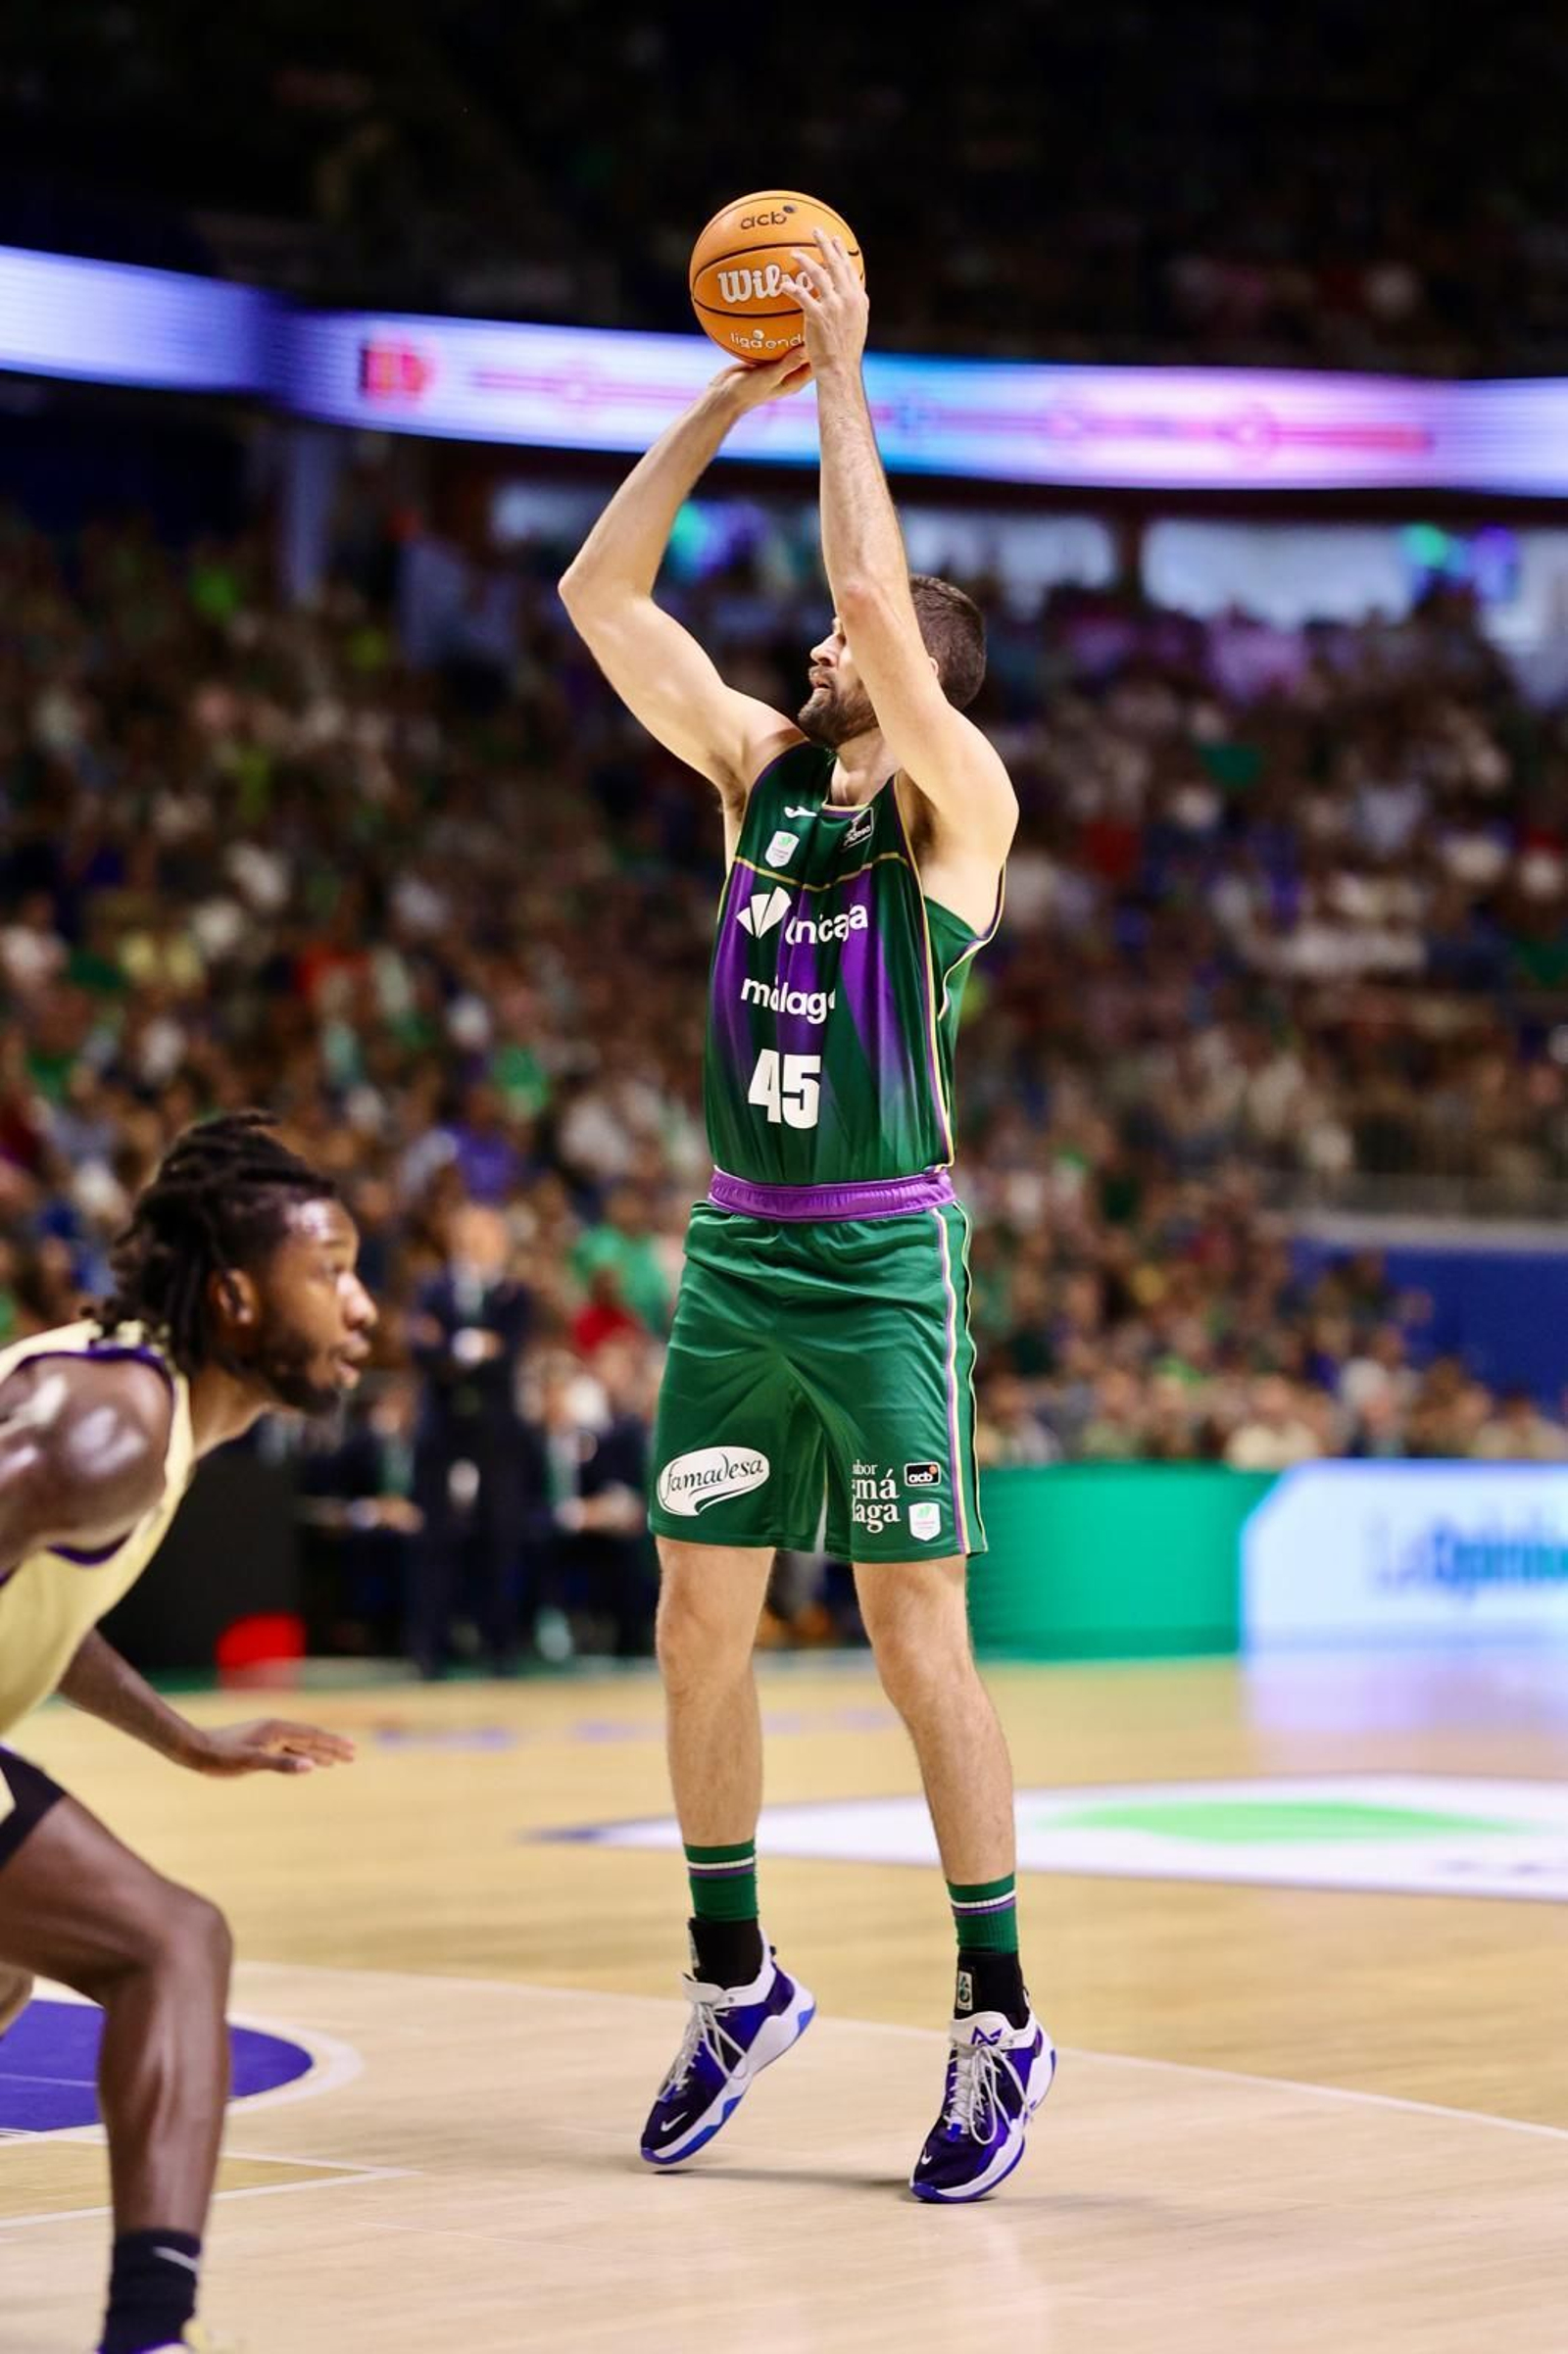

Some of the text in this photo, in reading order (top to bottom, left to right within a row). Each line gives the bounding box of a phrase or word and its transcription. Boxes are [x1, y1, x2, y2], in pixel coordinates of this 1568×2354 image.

[740, 211, 787, 230] acb
[717, 264, 814, 303] Wilso
[764, 333, 802, 349] end
[748, 1048, 821, 1129] 45
[662, 1452, 764, 1500] famadesa
[907, 1472, 933, 1484] acb
